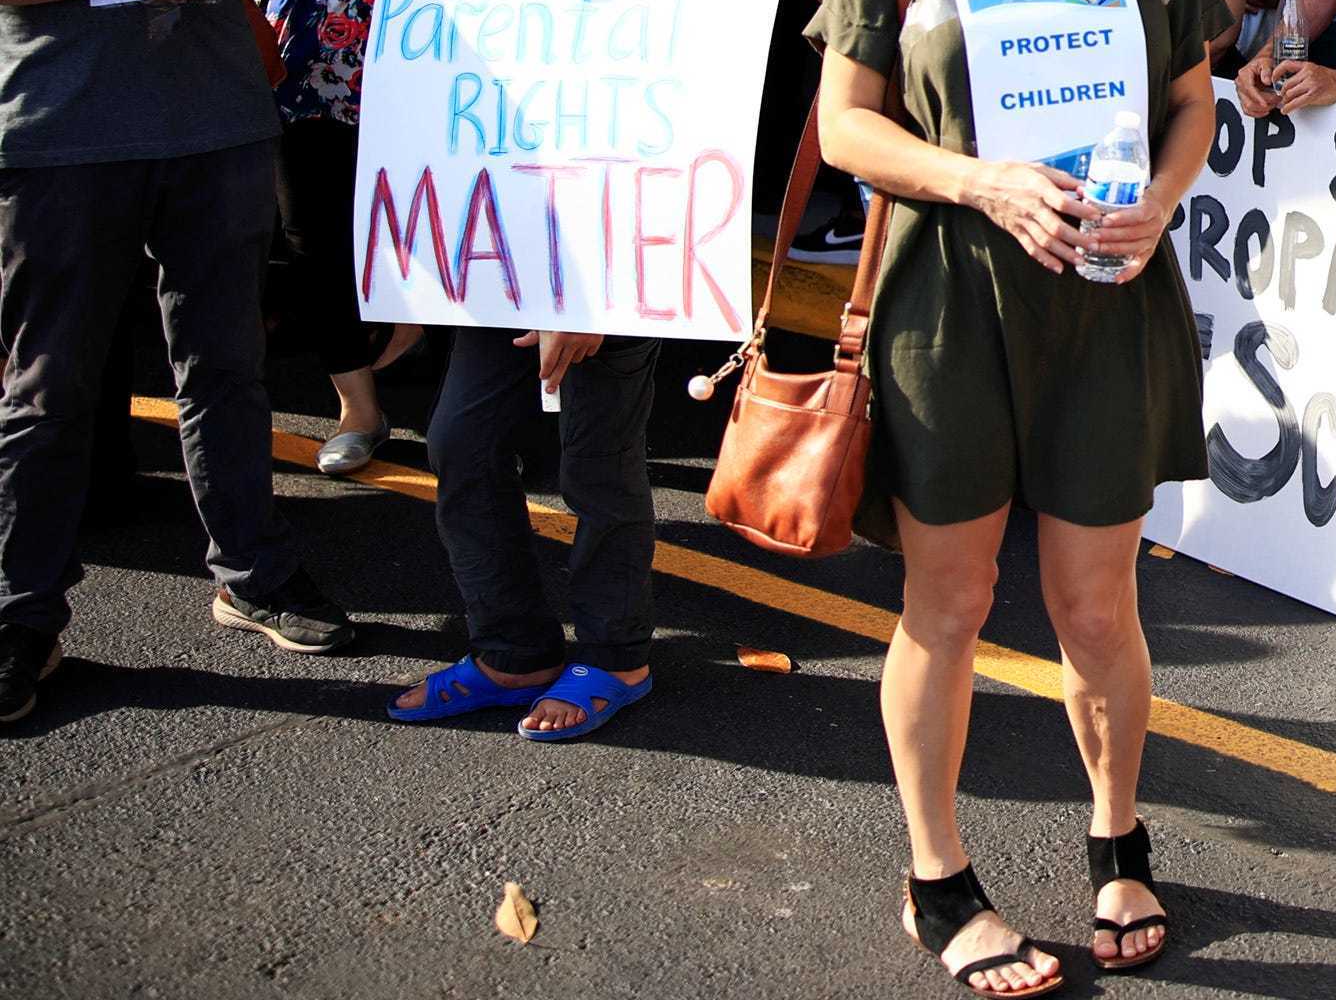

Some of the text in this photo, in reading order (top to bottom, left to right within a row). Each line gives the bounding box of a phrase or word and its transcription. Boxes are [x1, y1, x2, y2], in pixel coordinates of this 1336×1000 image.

[1000, 29, 1113, 56] PROTECT
[445, 71, 684, 157] RIGHTS
[1000, 80, 1126, 110] CHILDREN
[362, 148, 746, 334] MATTER
